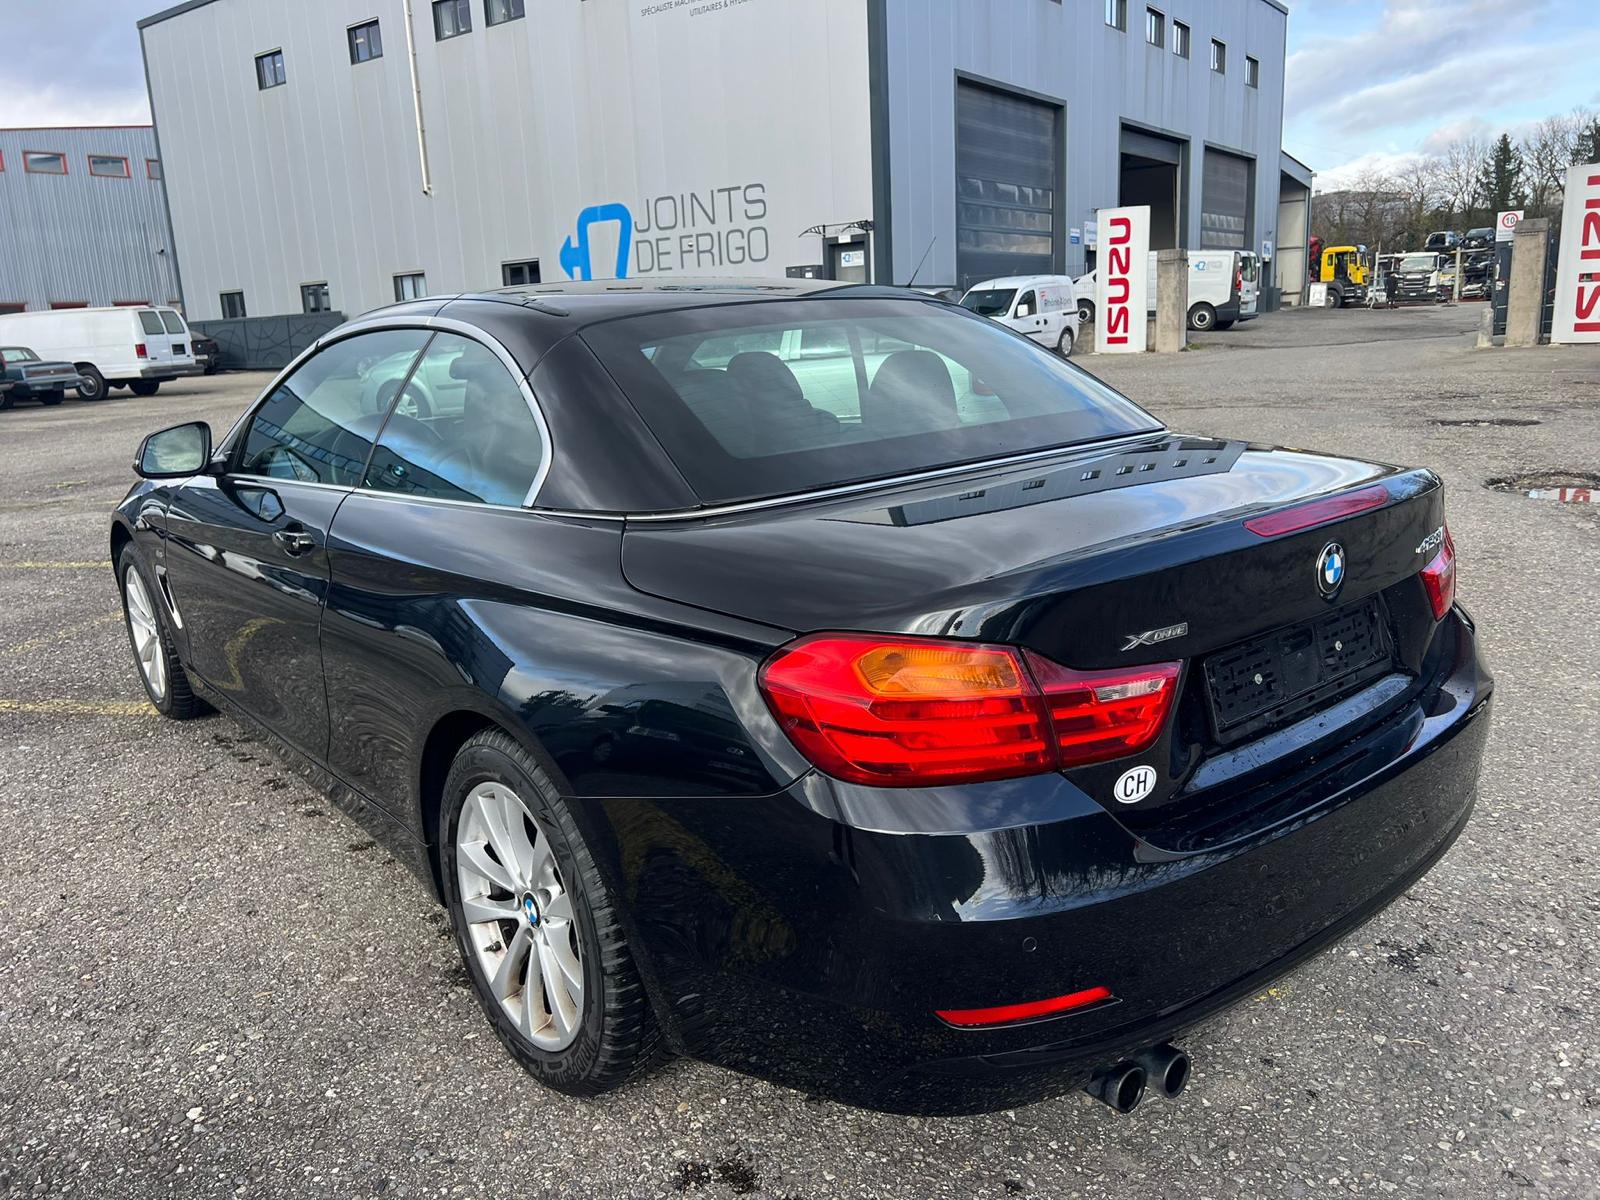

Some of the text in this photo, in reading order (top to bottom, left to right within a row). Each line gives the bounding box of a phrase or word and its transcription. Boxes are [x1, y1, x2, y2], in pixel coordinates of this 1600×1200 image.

[634, 183, 767, 233] JOINTS
[1505, 216, 1516, 225] 10
[636, 226, 769, 273] DE FRIGO
[1107, 217, 1131, 344] ISUZU
[1124, 771, 1148, 798] CH
